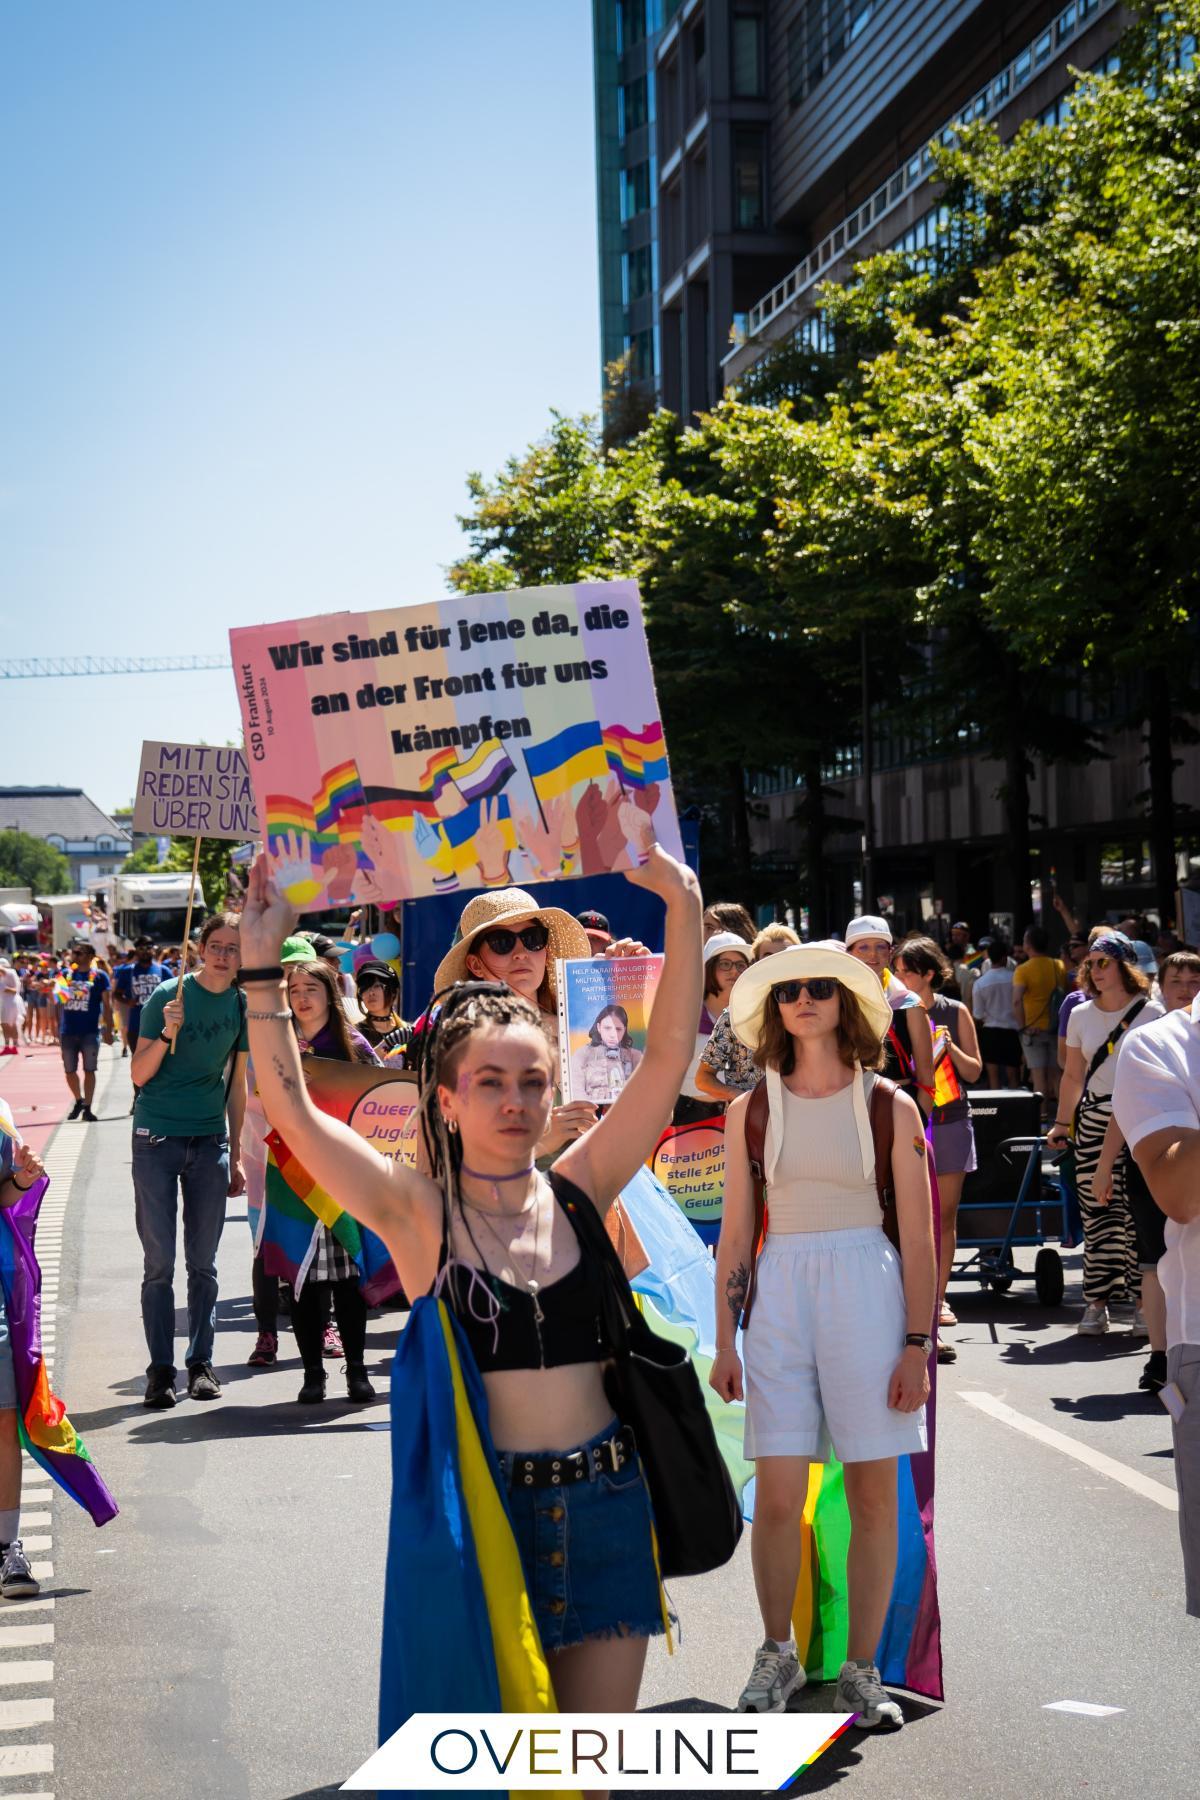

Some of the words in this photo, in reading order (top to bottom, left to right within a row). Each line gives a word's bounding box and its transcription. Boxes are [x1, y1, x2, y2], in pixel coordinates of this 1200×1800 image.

[267, 640, 324, 671] Wir
[331, 630, 399, 663] sind
[404, 624, 451, 652] für
[457, 619, 526, 651] jene
[531, 610, 579, 637] da,
[584, 604, 630, 631] die
[242, 663, 261, 729] Frankfurt
[310, 691, 350, 716] an
[355, 683, 407, 709] der
[413, 667, 496, 701] Front
[501, 661, 547, 689] für
[553, 659, 609, 683] uns
[250, 731, 266, 762] CSD
[391, 715, 532, 754] kämpfen
[159, 747, 211, 771] MIT
[141, 771, 213, 797] REDEN
[215, 775, 255, 802] STA
[153, 798, 212, 830] ÜBER
[590, 966, 628, 974] UKRAINIAN
[607, 974, 636, 982] ACHIEVE
[582, 984, 631, 992] PARTNERSHIPS
[667, 1168, 702, 1179] stelle
[668, 1181, 714, 1195] Schutz
